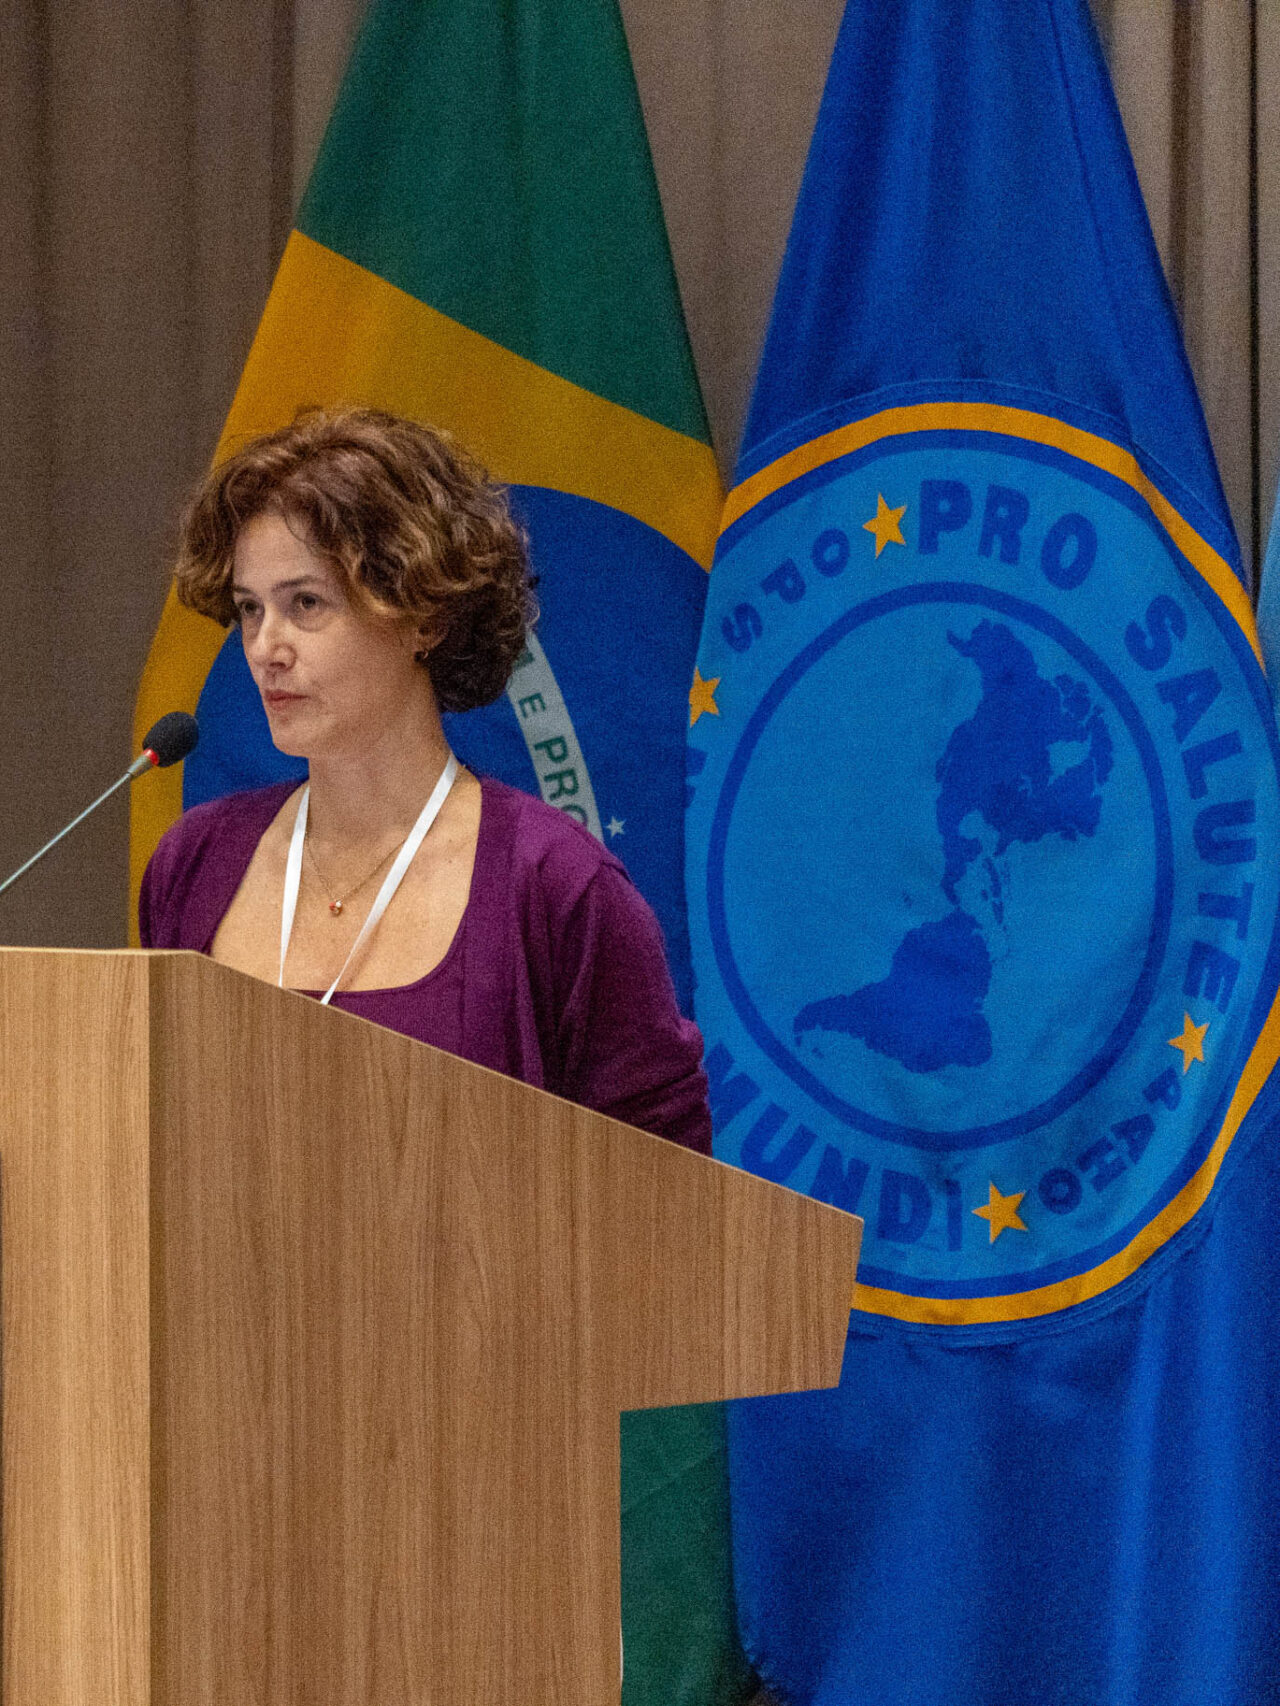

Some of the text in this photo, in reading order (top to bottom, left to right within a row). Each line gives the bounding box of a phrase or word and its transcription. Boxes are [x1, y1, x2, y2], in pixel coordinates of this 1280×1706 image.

[721, 528, 851, 653] OPS
[518, 693, 546, 719] E
[919, 479, 1257, 1015] PRO SALUTE
[1037, 1066, 1183, 1215] PAHO
